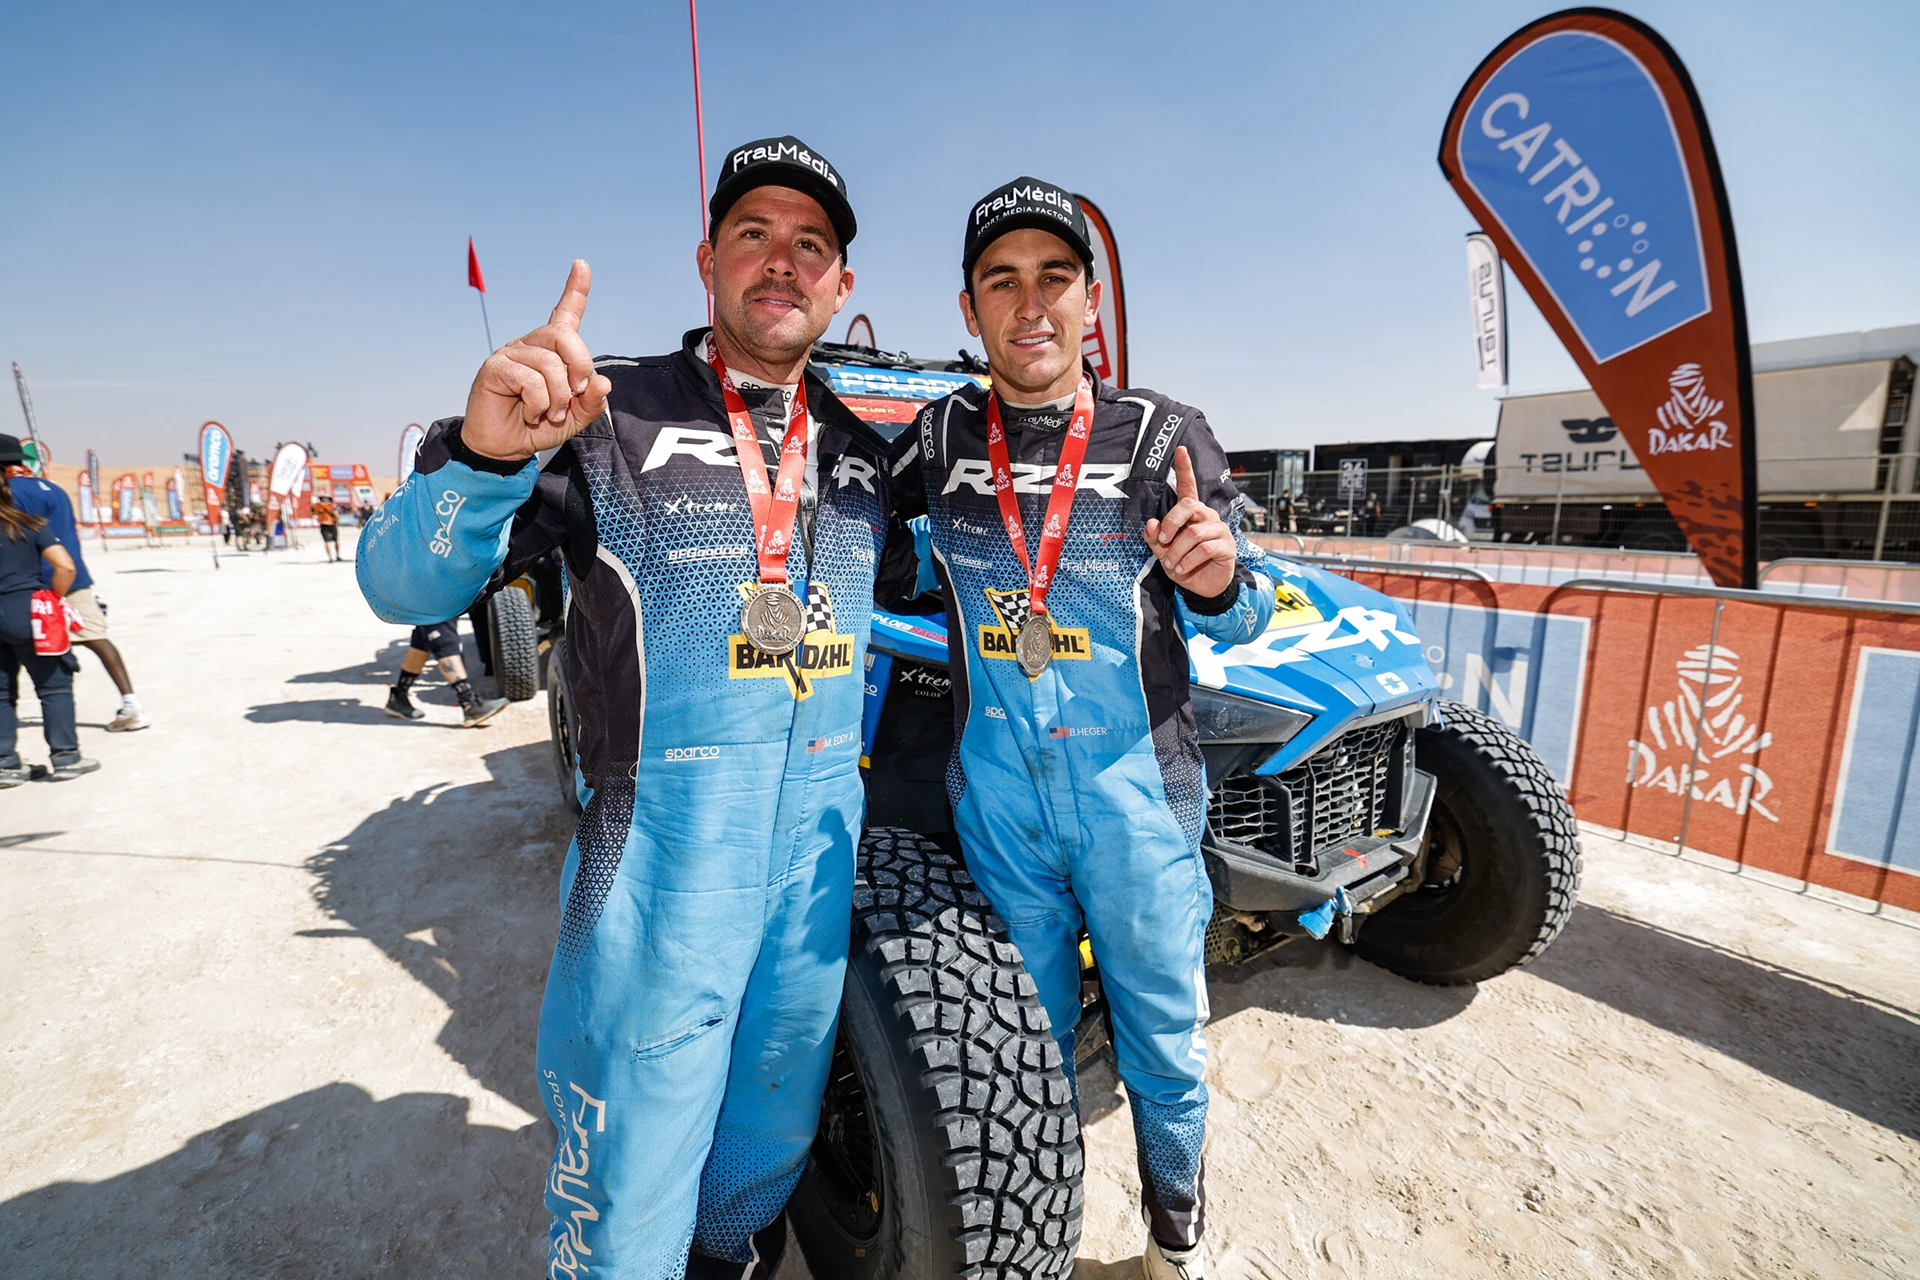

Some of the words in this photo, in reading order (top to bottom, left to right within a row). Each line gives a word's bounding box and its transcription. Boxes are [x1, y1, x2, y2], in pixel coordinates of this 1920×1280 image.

[976, 185, 1073, 225] FrayMédia
[977, 215, 1000, 237] SPORT
[1003, 206, 1033, 218] MEDIA
[1036, 207, 1074, 226] FACTORY
[921, 407, 936, 460] sparco
[1145, 414, 1183, 471] sparco
[1648, 421, 1734, 456] DAKAR
[429, 489, 467, 559] spco
[668, 545, 748, 564] BFGoodrich
[983, 632, 1085, 654] BAHL
[915, 689, 942, 698] COLOR
[985, 706, 1007, 719] spa
[833, 733, 848, 745] EDDY
[1069, 725, 1107, 737] B.HEGER
[665, 745, 720, 762] sparco
[1625, 739, 1780, 823] DAKAR
